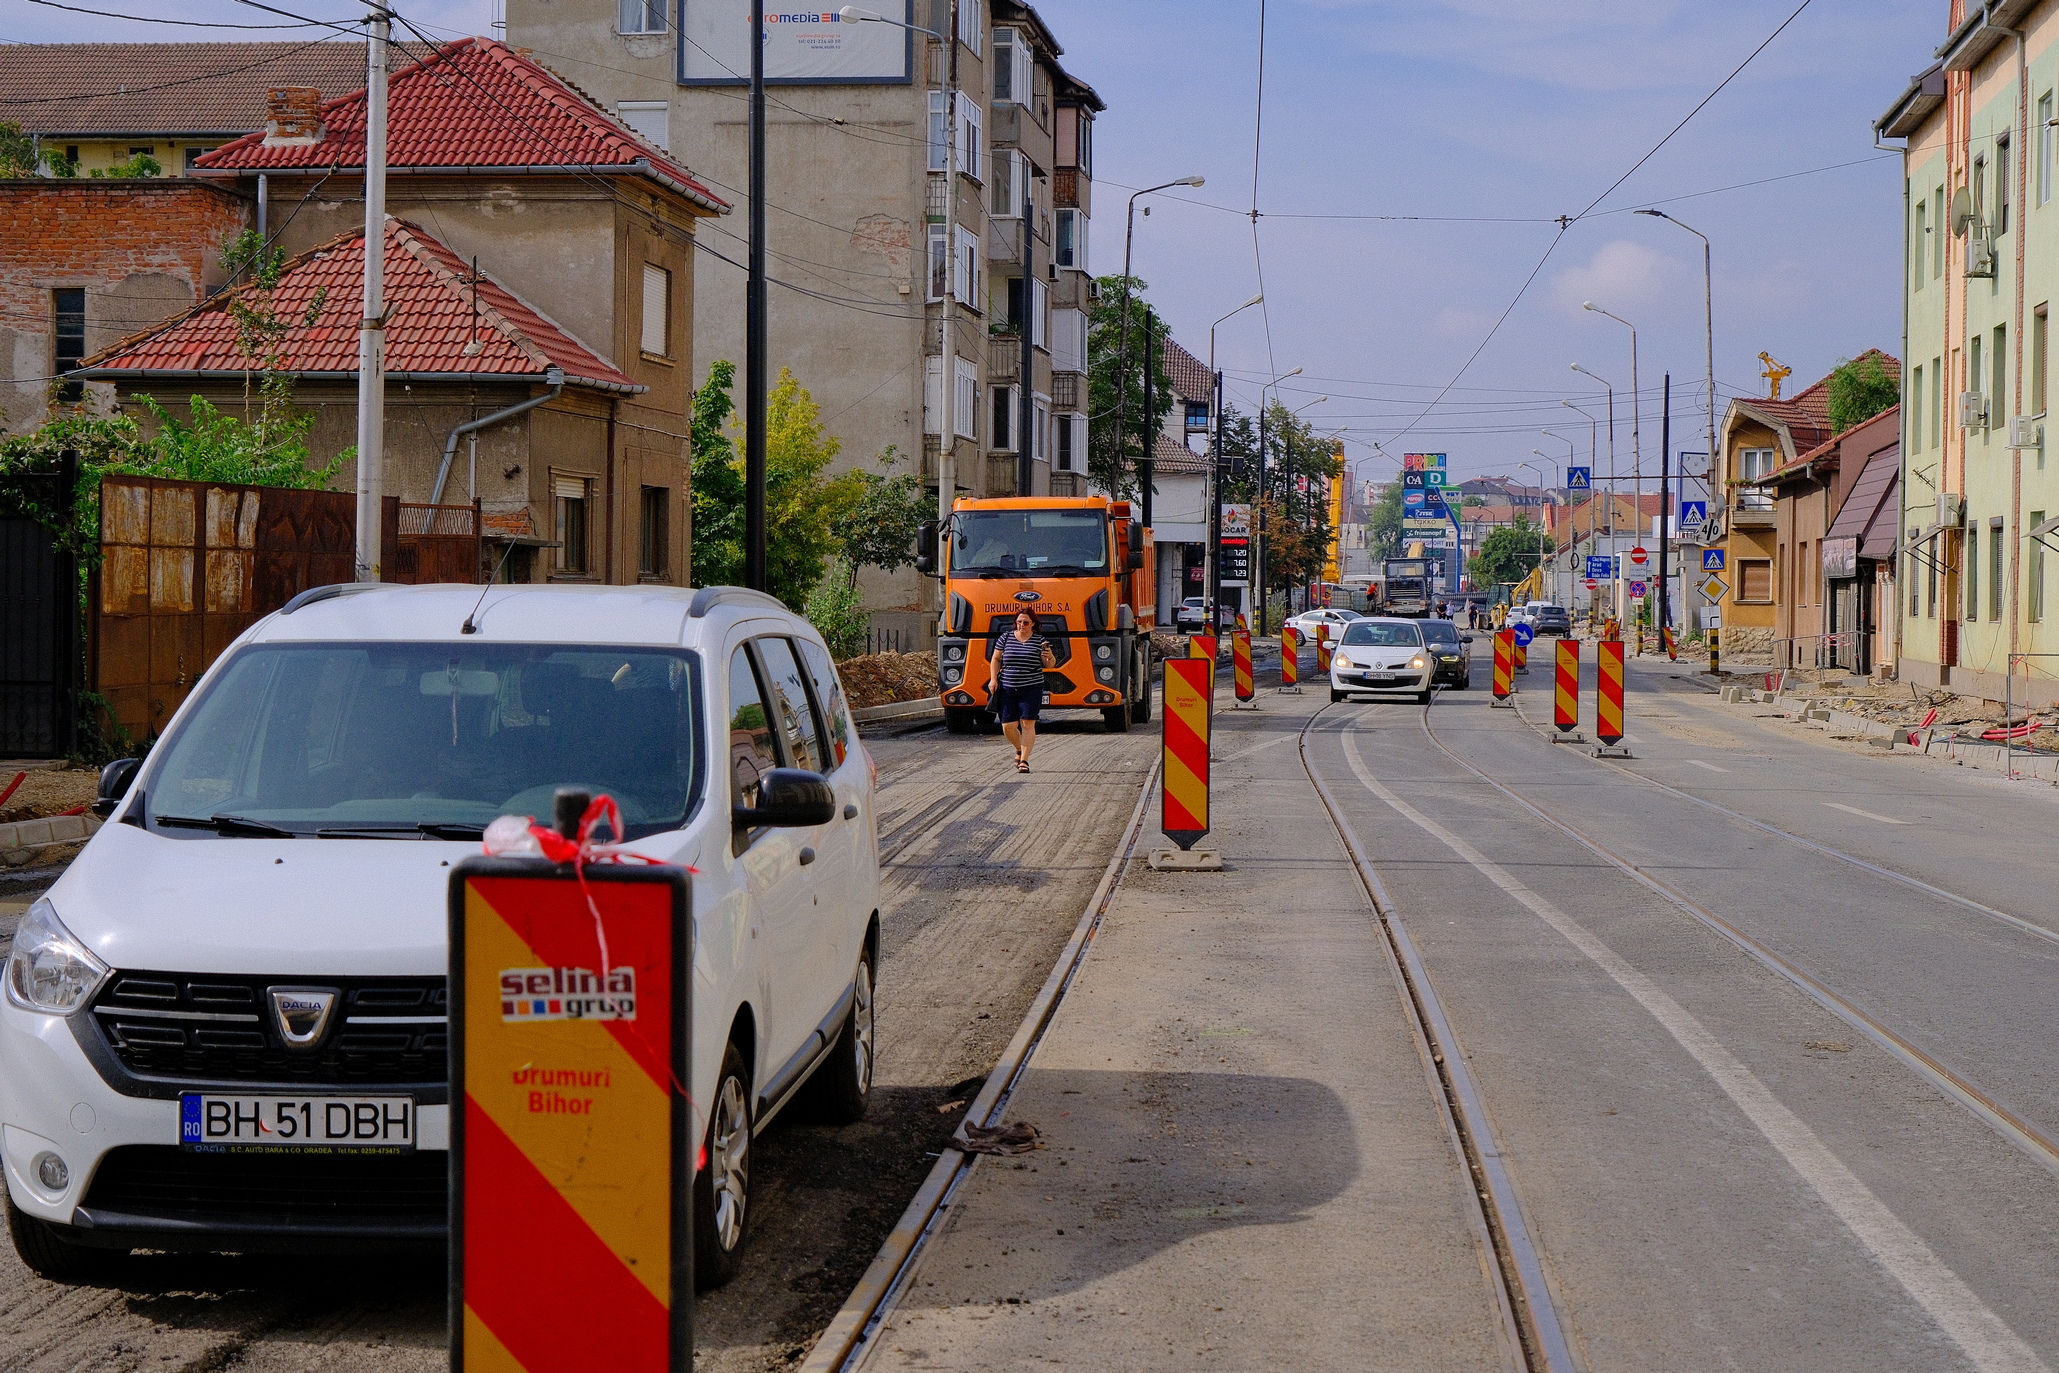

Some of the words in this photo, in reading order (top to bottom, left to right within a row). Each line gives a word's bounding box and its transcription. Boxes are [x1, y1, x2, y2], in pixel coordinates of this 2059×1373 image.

[501, 967, 633, 995] selina
[282, 1001, 321, 1009] DACIA
[528, 1091, 594, 1114] Bihor
[184, 1121, 200, 1137] RO
[206, 1101, 260, 1137] BH
[276, 1102, 311, 1138] 51
[325, 1103, 408, 1139] DBH
